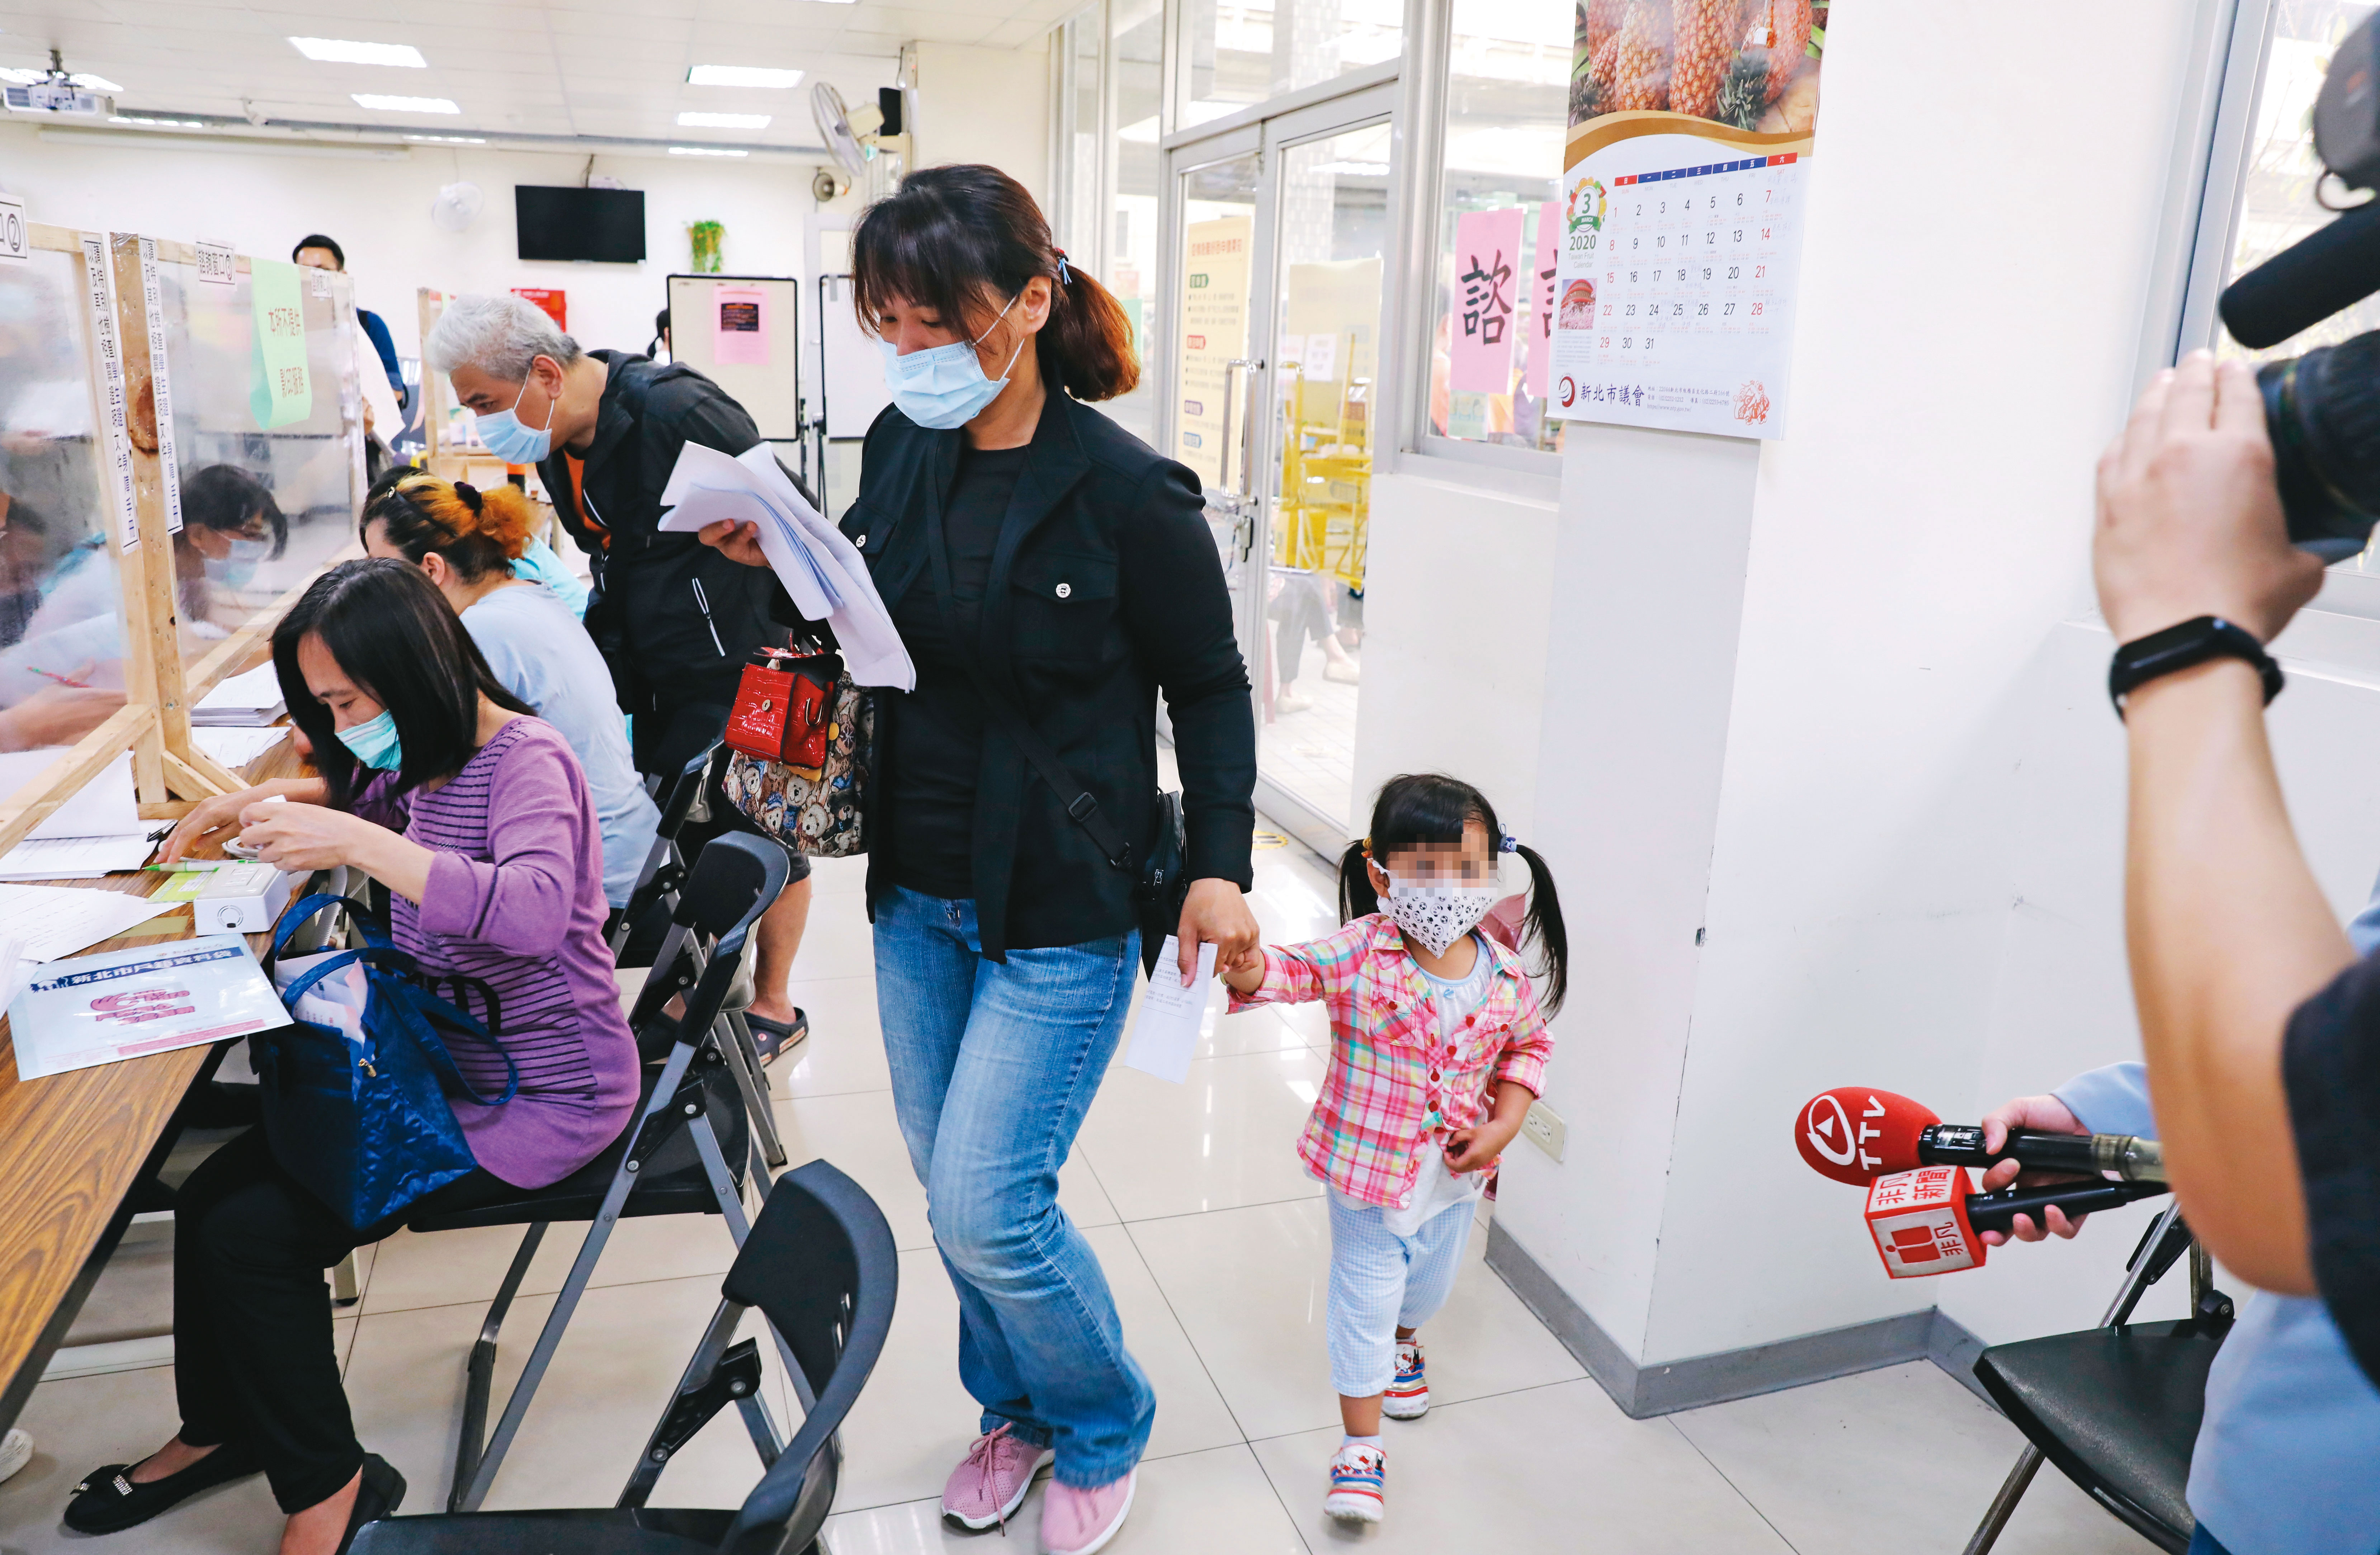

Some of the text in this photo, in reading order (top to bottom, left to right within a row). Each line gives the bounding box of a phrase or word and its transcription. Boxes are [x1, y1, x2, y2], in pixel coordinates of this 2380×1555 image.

[1582, 193, 1591, 214] 3
[1614, 207, 1617, 217] 1
[1636, 204, 1641, 216] 2
[1660, 202, 1666, 213] 3
[1685, 199, 1690, 211] 4
[1710, 196, 1716, 208] 5
[1737, 193, 1743, 206] 6
[1766, 190, 1771, 203] 7
[1569, 235, 1596, 251] 2020
[1610, 240, 1615, 251] 8
[1633, 238, 1638, 249] 9
[1657, 236, 1665, 247] 10
[1682, 234, 1688, 246] 11
[1706, 232, 1715, 244] 12
[1733, 230, 1743, 242] 13
[1761, 228, 1770, 240] 14
[1607, 272, 1614, 283] 15
[1630, 271, 1638, 283] 16
[1653, 270, 1661, 282] 17
[1677, 269, 1686, 281] 18
[1703, 268, 1711, 280] 19
[1728, 266, 1739, 279] 20
[1755, 265, 1765, 278] 21
[1461, 249, 1512, 346] 諮
[1603, 304, 1612, 316] 22
[1626, 304, 1635, 316] 23
[1649, 304, 1659, 316] 24
[1673, 304, 1683, 316] 25
[1698, 303, 1709, 316] 26
[1724, 303, 1736, 315] 27
[1751, 303, 1763, 315] 28
[1600, 337, 1654, 349] 29 30 31
[1581, 382, 1644, 407] 新北市議會
[1859, 1095, 1886, 1170] TTV
[1876, 1173, 1912, 1205] 非凡
[1912, 1169, 1950, 1200] 新聞
[1934, 1222, 1963, 1256] 非凡
